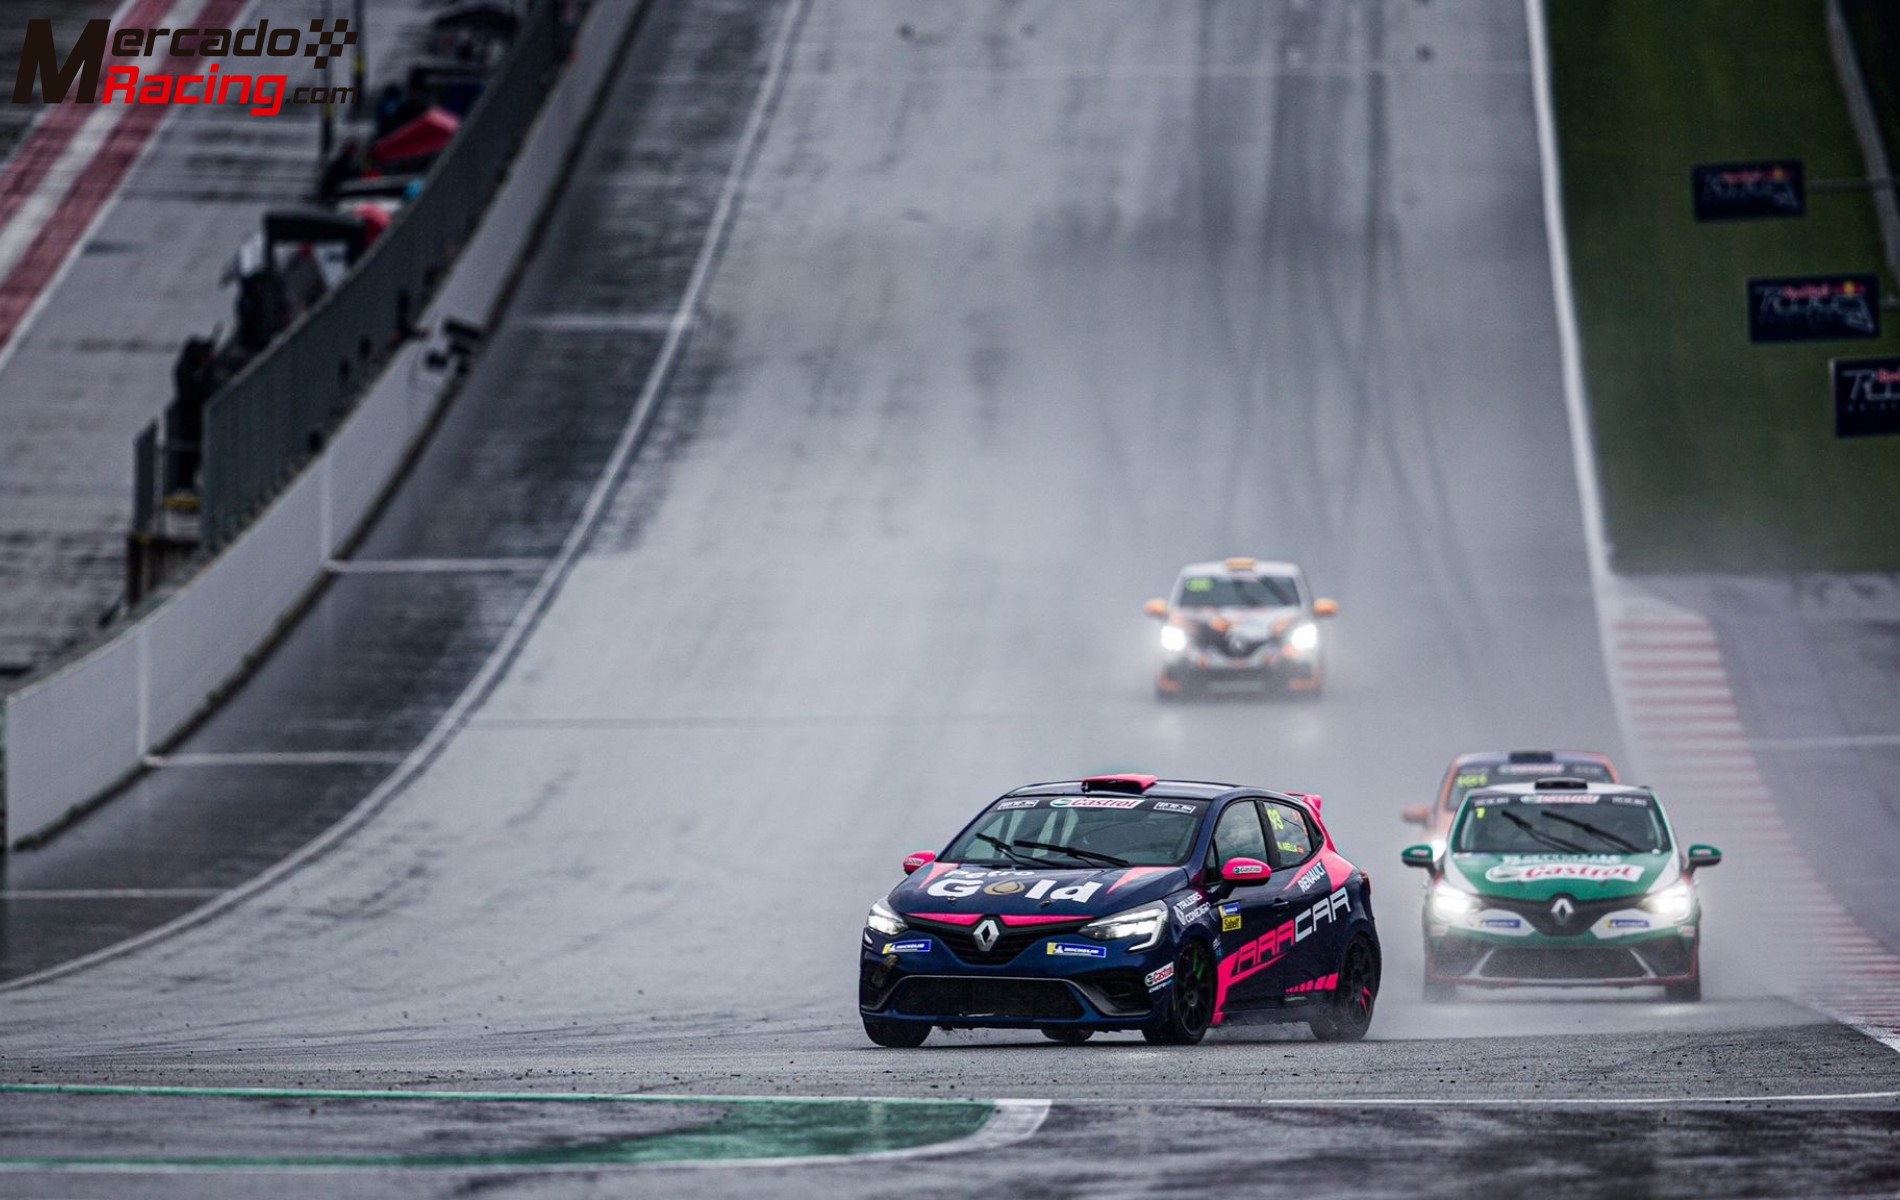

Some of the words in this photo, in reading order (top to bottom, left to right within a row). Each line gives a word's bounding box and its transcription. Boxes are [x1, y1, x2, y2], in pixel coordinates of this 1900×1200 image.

[1071, 799, 1140, 808] Castrol
[1267, 809, 1284, 830] 93
[1297, 862, 1326, 893] RENAULT
[1526, 866, 1633, 879] Castrol
